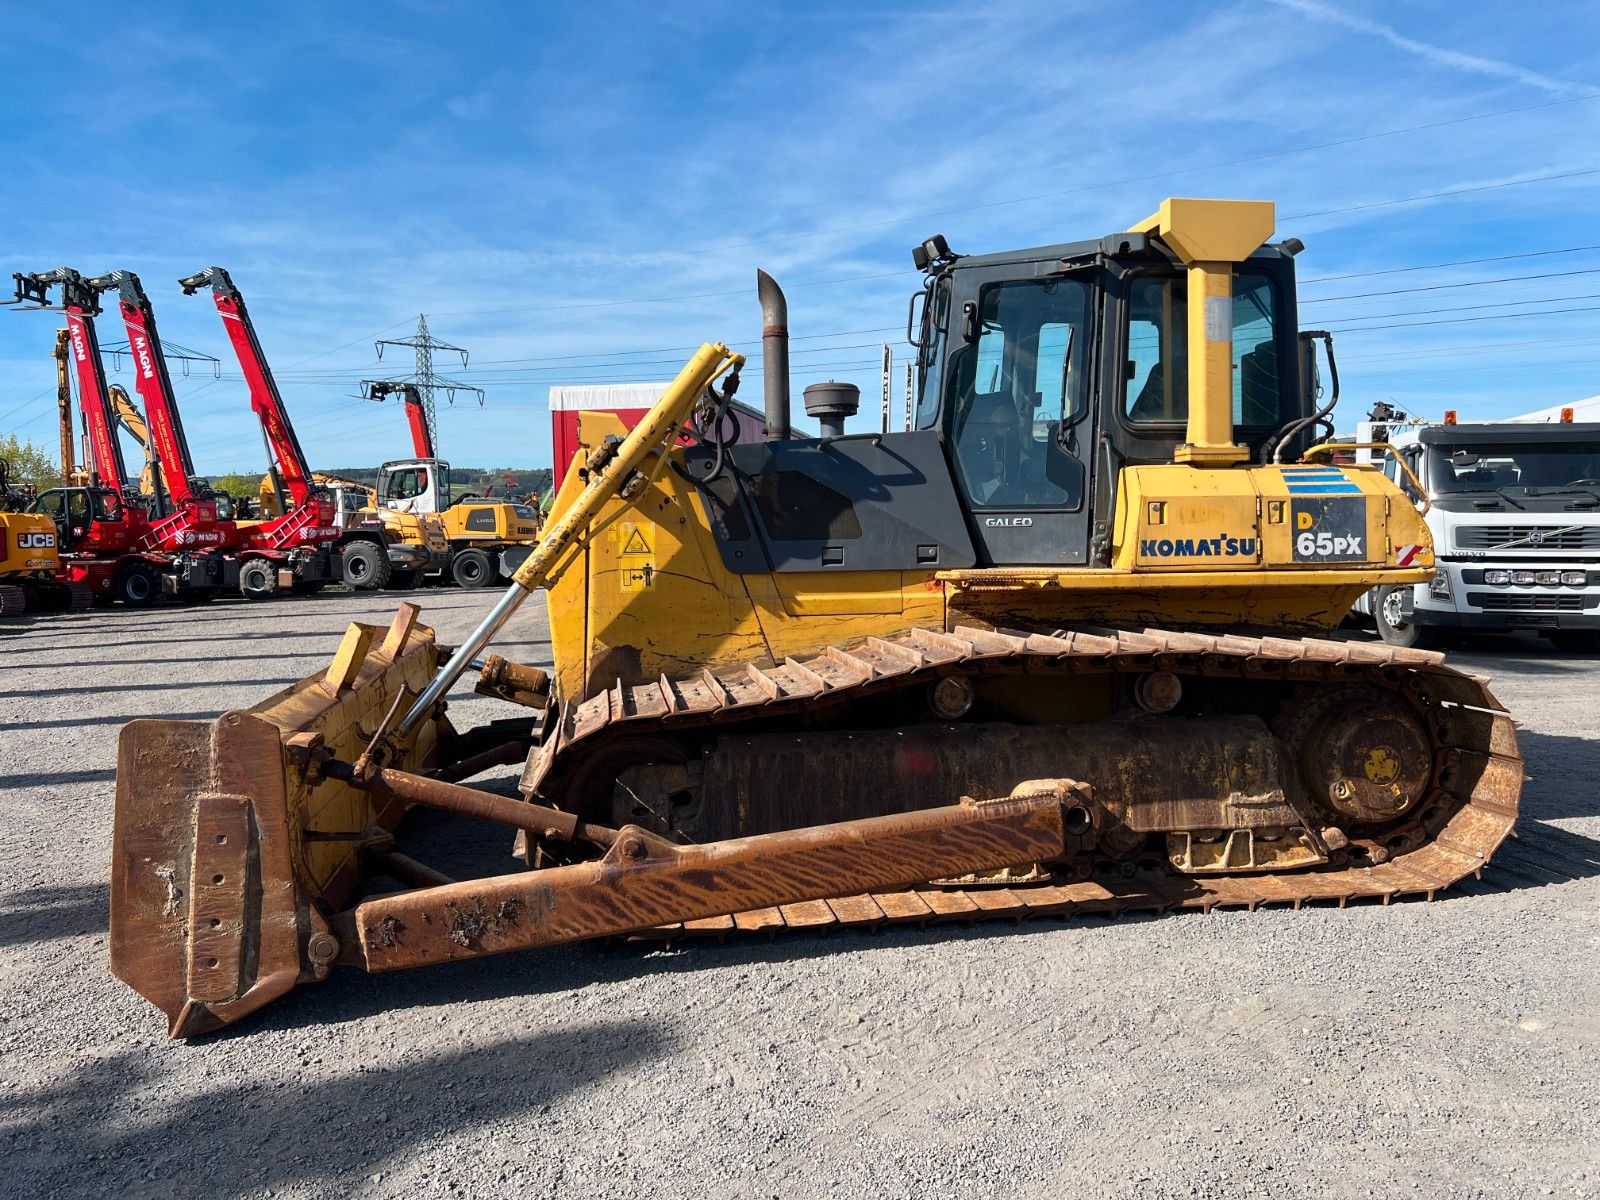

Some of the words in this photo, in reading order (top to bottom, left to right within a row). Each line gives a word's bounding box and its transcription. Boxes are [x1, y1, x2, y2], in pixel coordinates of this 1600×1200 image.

[71, 324, 86, 362] MAGNI
[135, 337, 153, 378] MAGNI
[986, 518, 1032, 527] GALEO
[1297, 512, 1312, 530] D
[19, 534, 54, 547] JCB
[1140, 534, 1255, 557] KOMATSU
